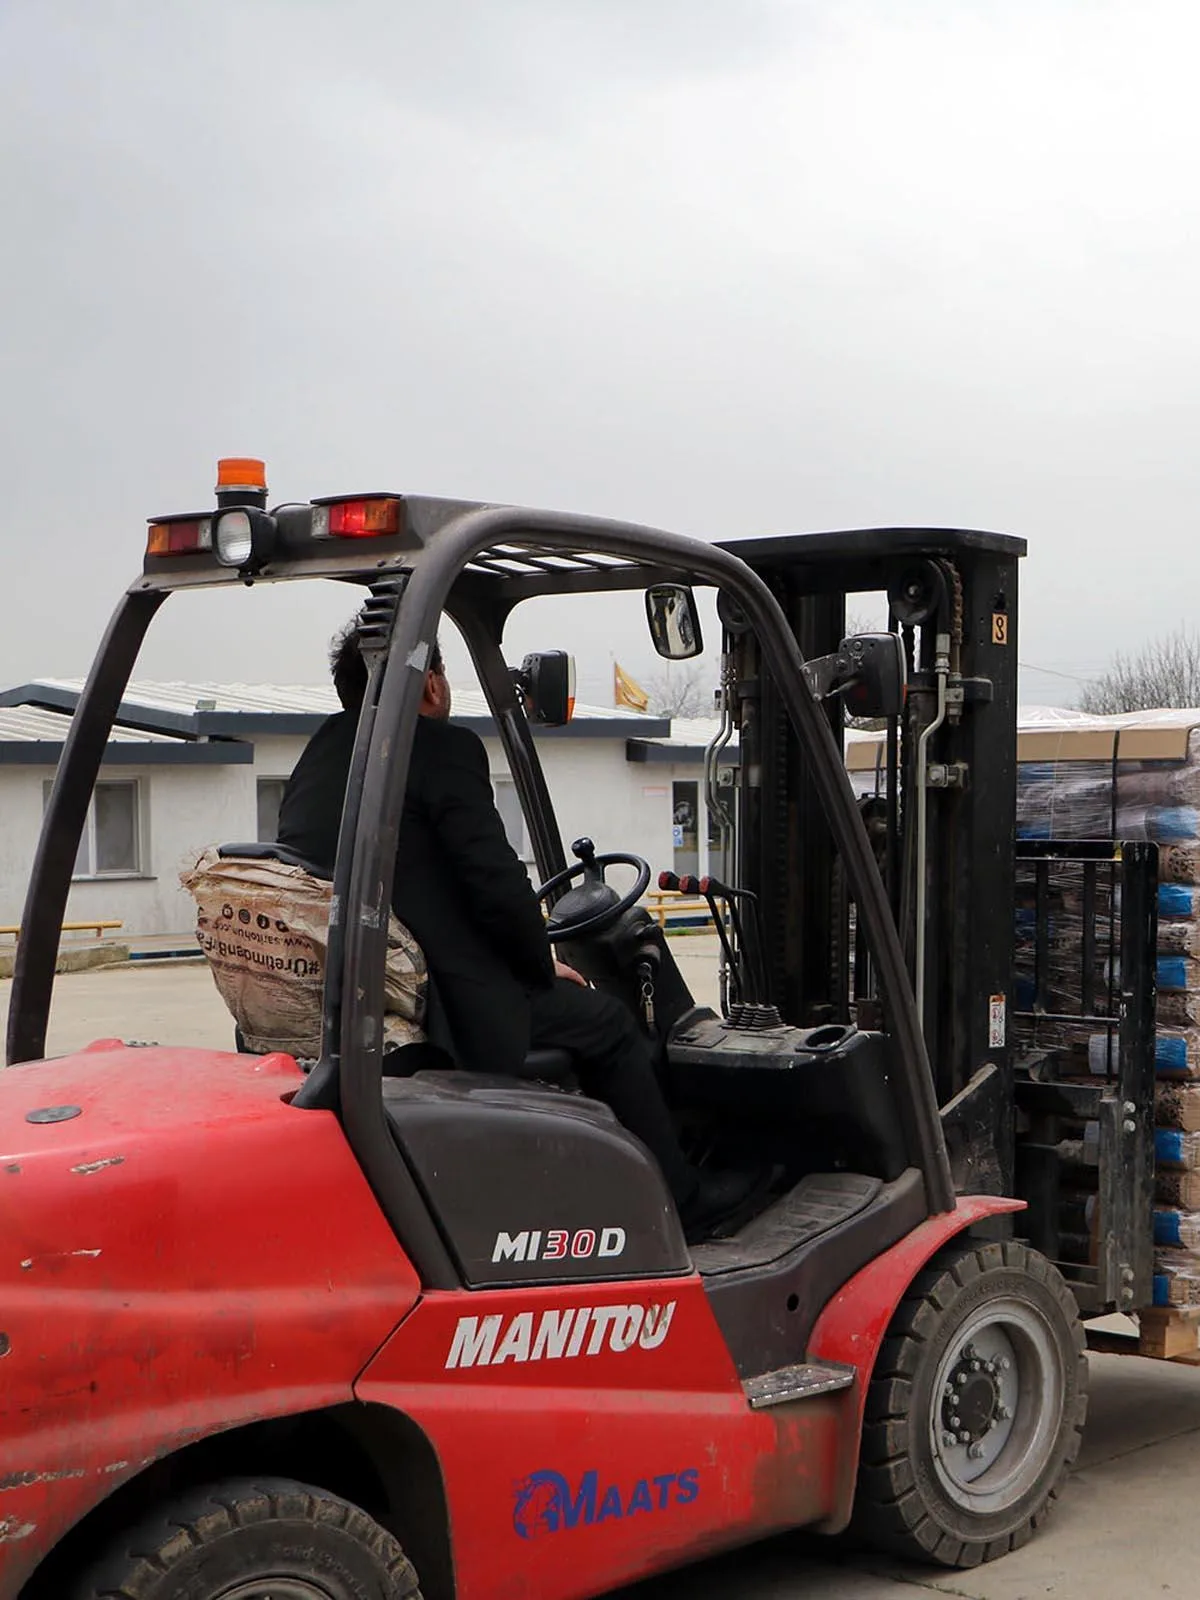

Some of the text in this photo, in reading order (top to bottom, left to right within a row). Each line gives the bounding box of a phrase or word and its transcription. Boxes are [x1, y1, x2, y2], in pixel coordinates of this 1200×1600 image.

[491, 1227, 627, 1263] MI30D
[444, 1300, 677, 1370] MANITOU
[540, 1467, 699, 1533] MAATS
